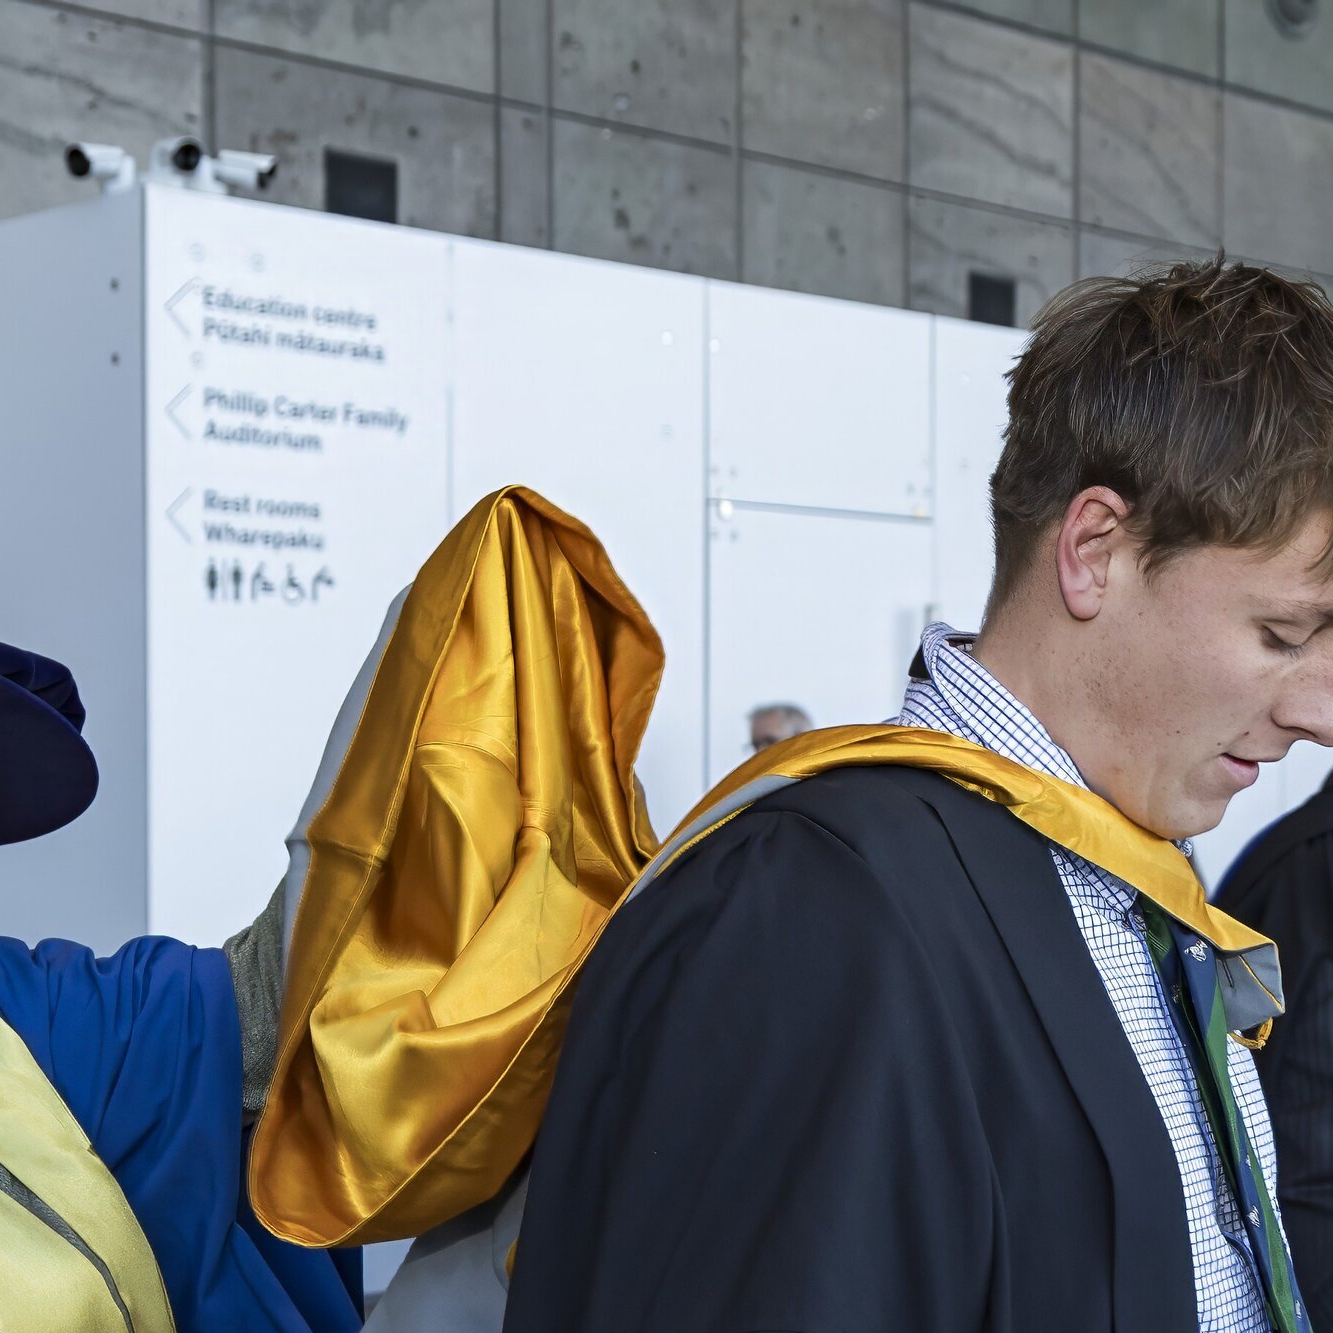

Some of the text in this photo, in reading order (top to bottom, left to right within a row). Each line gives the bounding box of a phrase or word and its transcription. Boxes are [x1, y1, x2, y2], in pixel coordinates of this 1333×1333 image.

[203, 285, 376, 331] Education centre
[273, 395, 337, 423] Carter
[342, 402, 408, 434] Family
[203, 419, 323, 450] Auditorium
[203, 489, 322, 519] Rest rooms
[203, 522, 325, 551] Wharepaku
